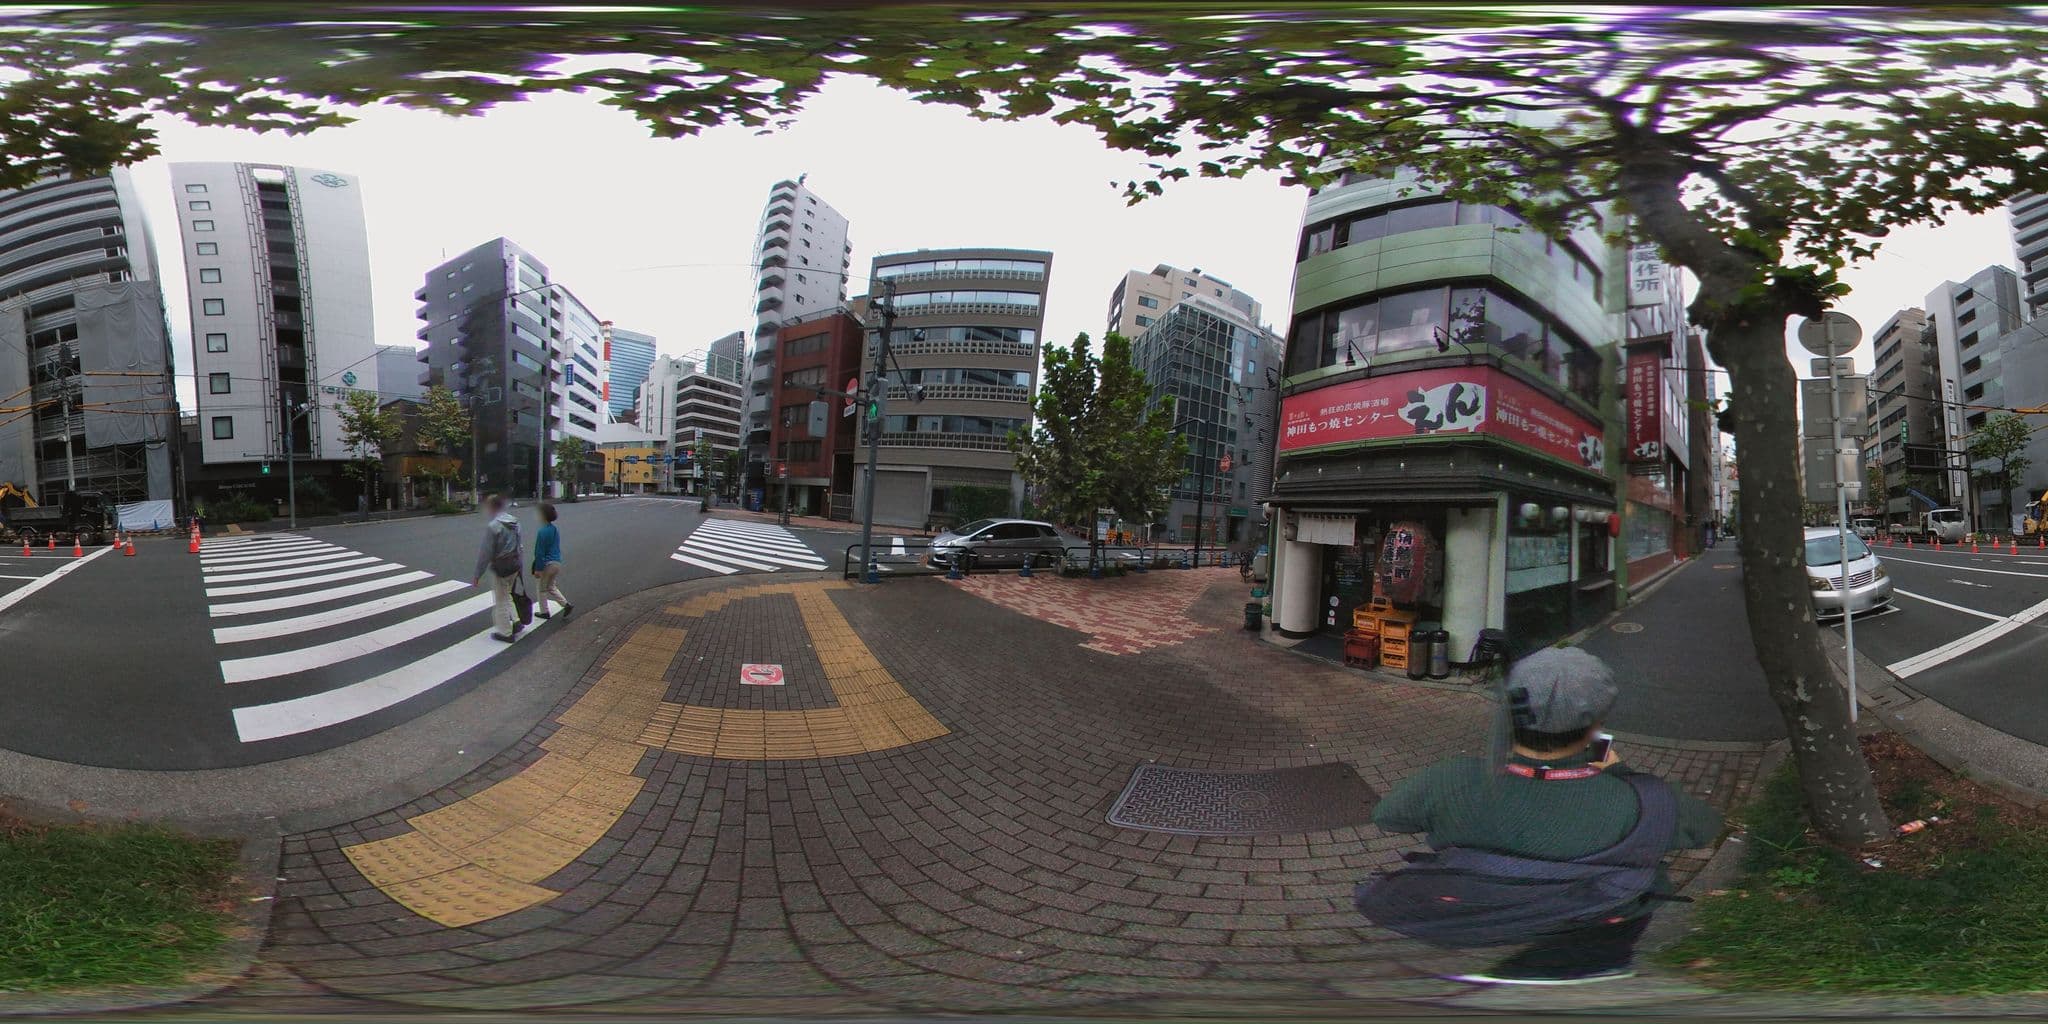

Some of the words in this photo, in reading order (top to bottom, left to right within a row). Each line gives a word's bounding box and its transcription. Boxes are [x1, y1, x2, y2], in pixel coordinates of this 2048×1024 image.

[1287, 412, 1395, 437] 神田もつ焼センター
[1407, 383, 1481, 434] えん
